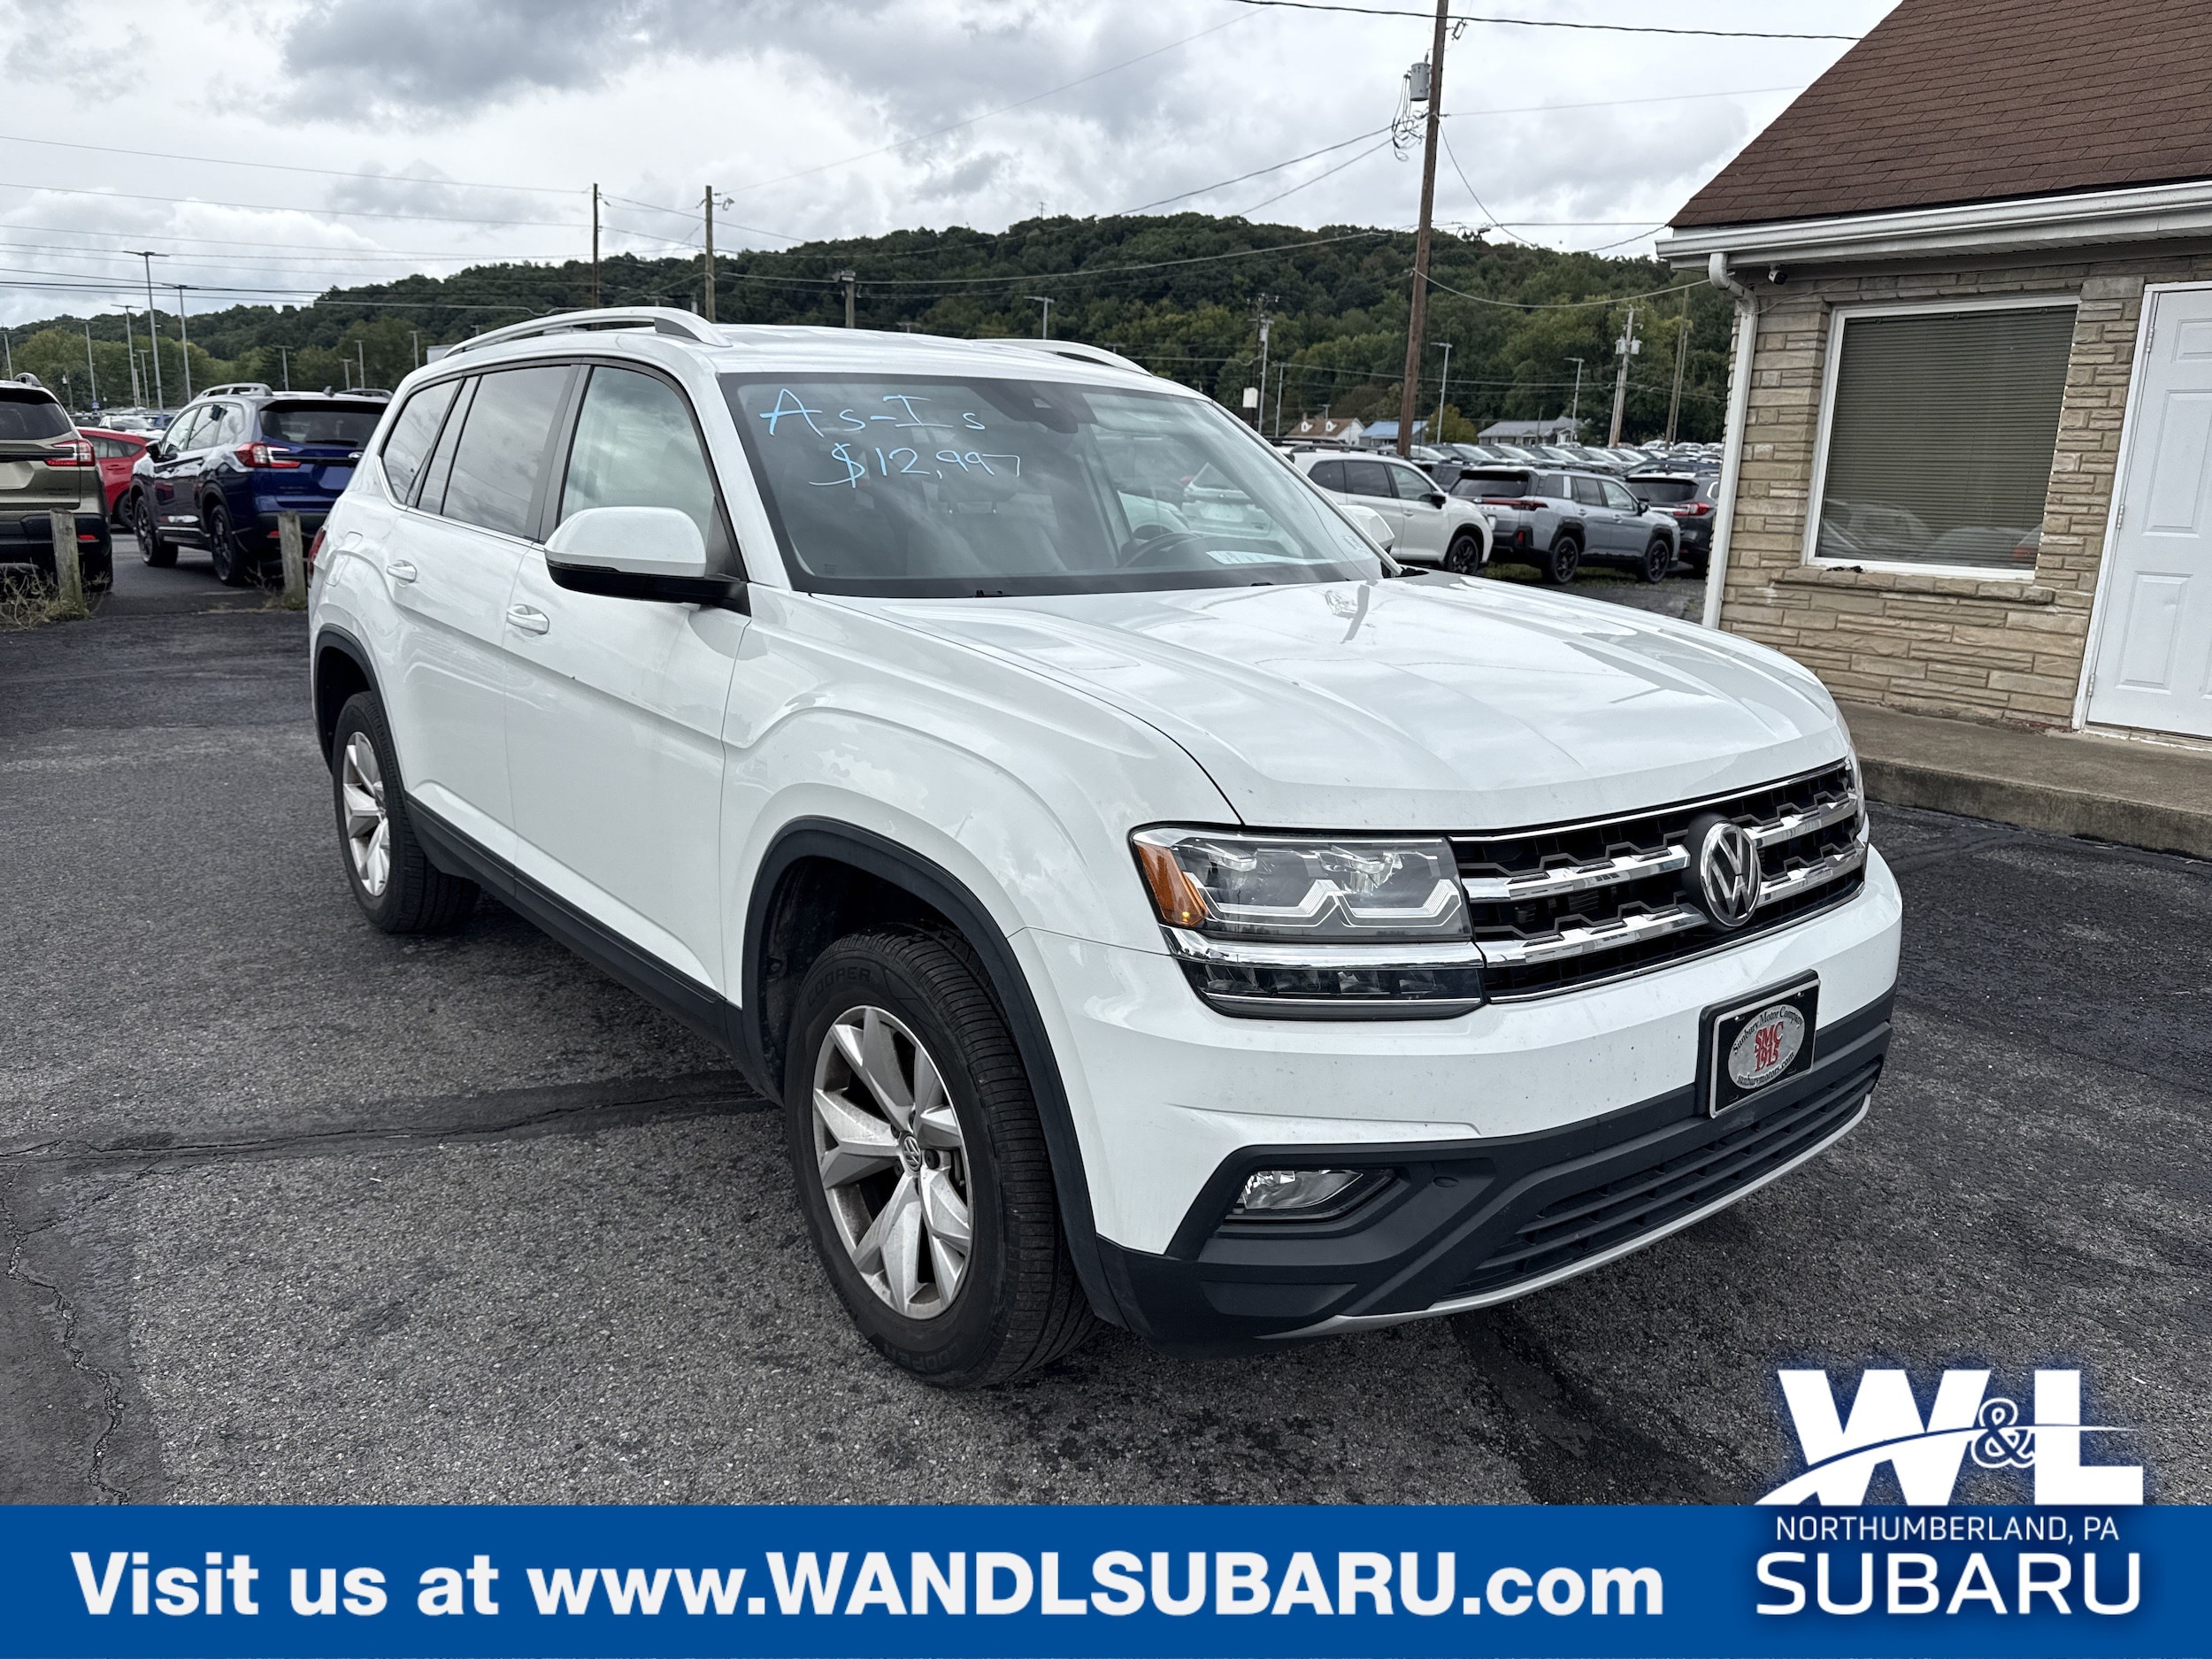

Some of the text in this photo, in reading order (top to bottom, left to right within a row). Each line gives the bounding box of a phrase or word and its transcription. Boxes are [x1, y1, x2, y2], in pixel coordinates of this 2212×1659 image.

[808, 442, 1020, 488] $12,997
[807, 965, 872, 1008] COOPER
[1732, 1005, 1803, 1055] Sunbury Motor Company
[1754, 1020, 1785, 1054] SMC
[1736, 1051, 1795, 1088] sunburymotors.com
[1754, 1045, 1779, 1072] 1915
